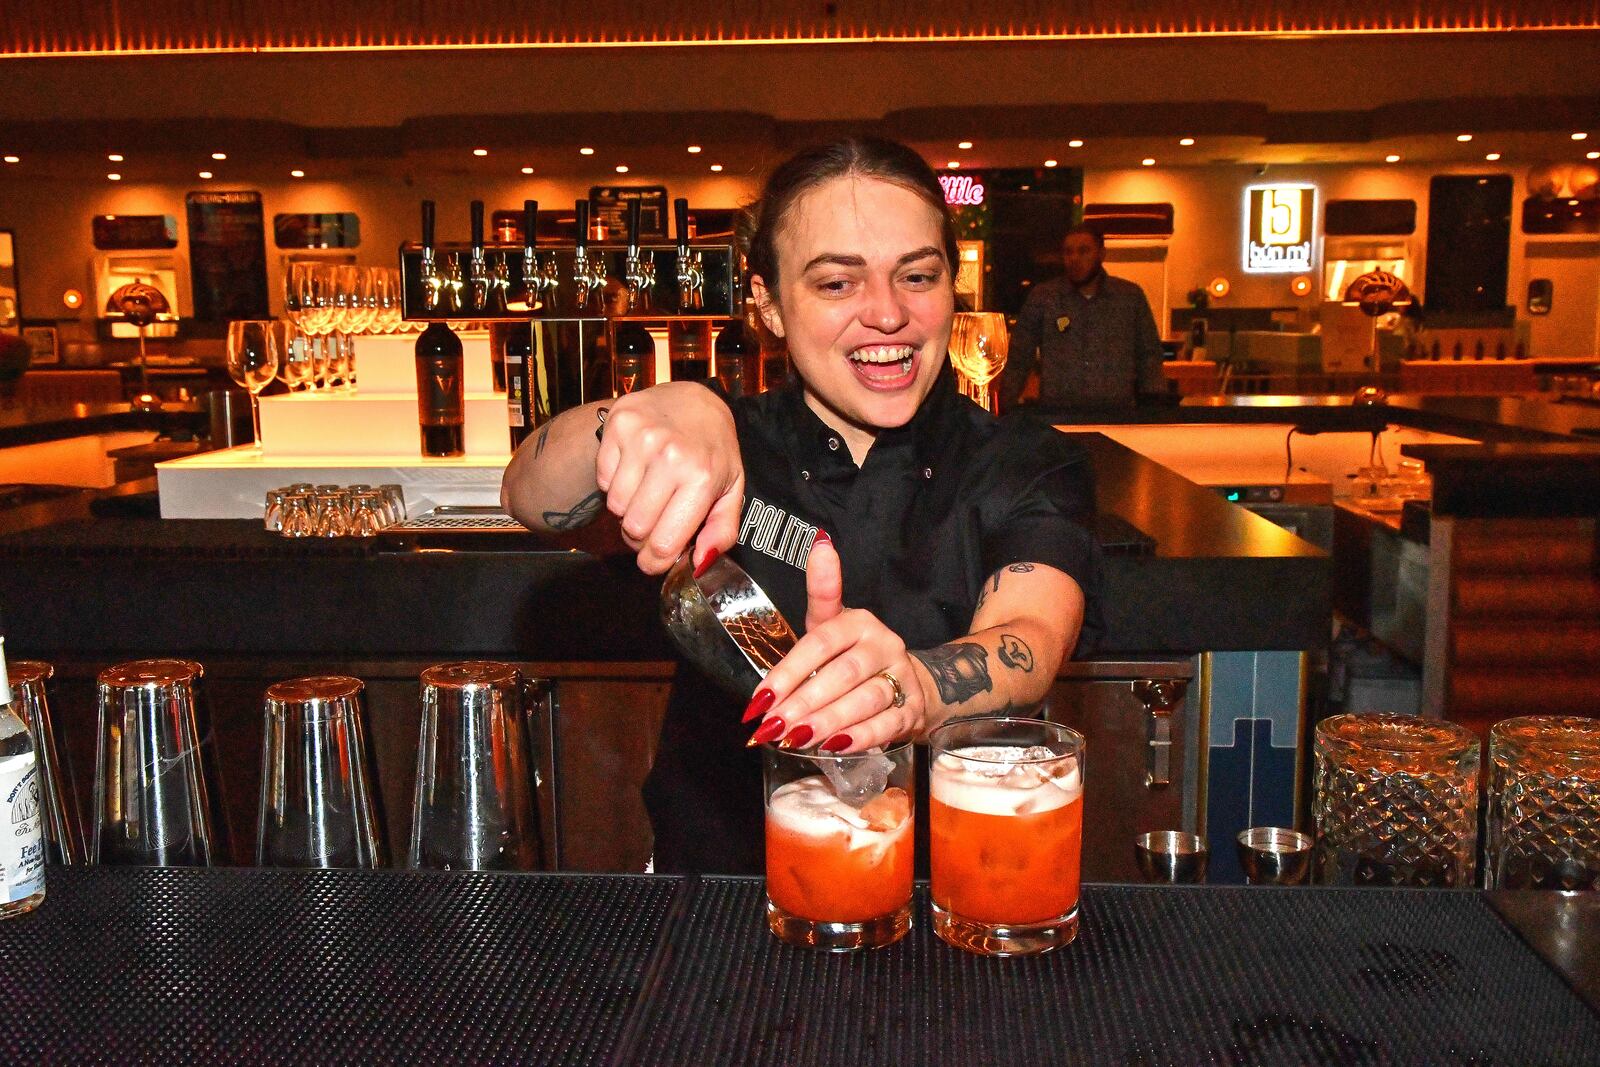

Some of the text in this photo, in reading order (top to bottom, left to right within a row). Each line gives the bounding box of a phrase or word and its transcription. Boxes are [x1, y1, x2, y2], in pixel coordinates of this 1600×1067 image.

[938, 176, 984, 205] ittle
[737, 498, 820, 571] POLITA
[21, 845, 37, 859] Fee
